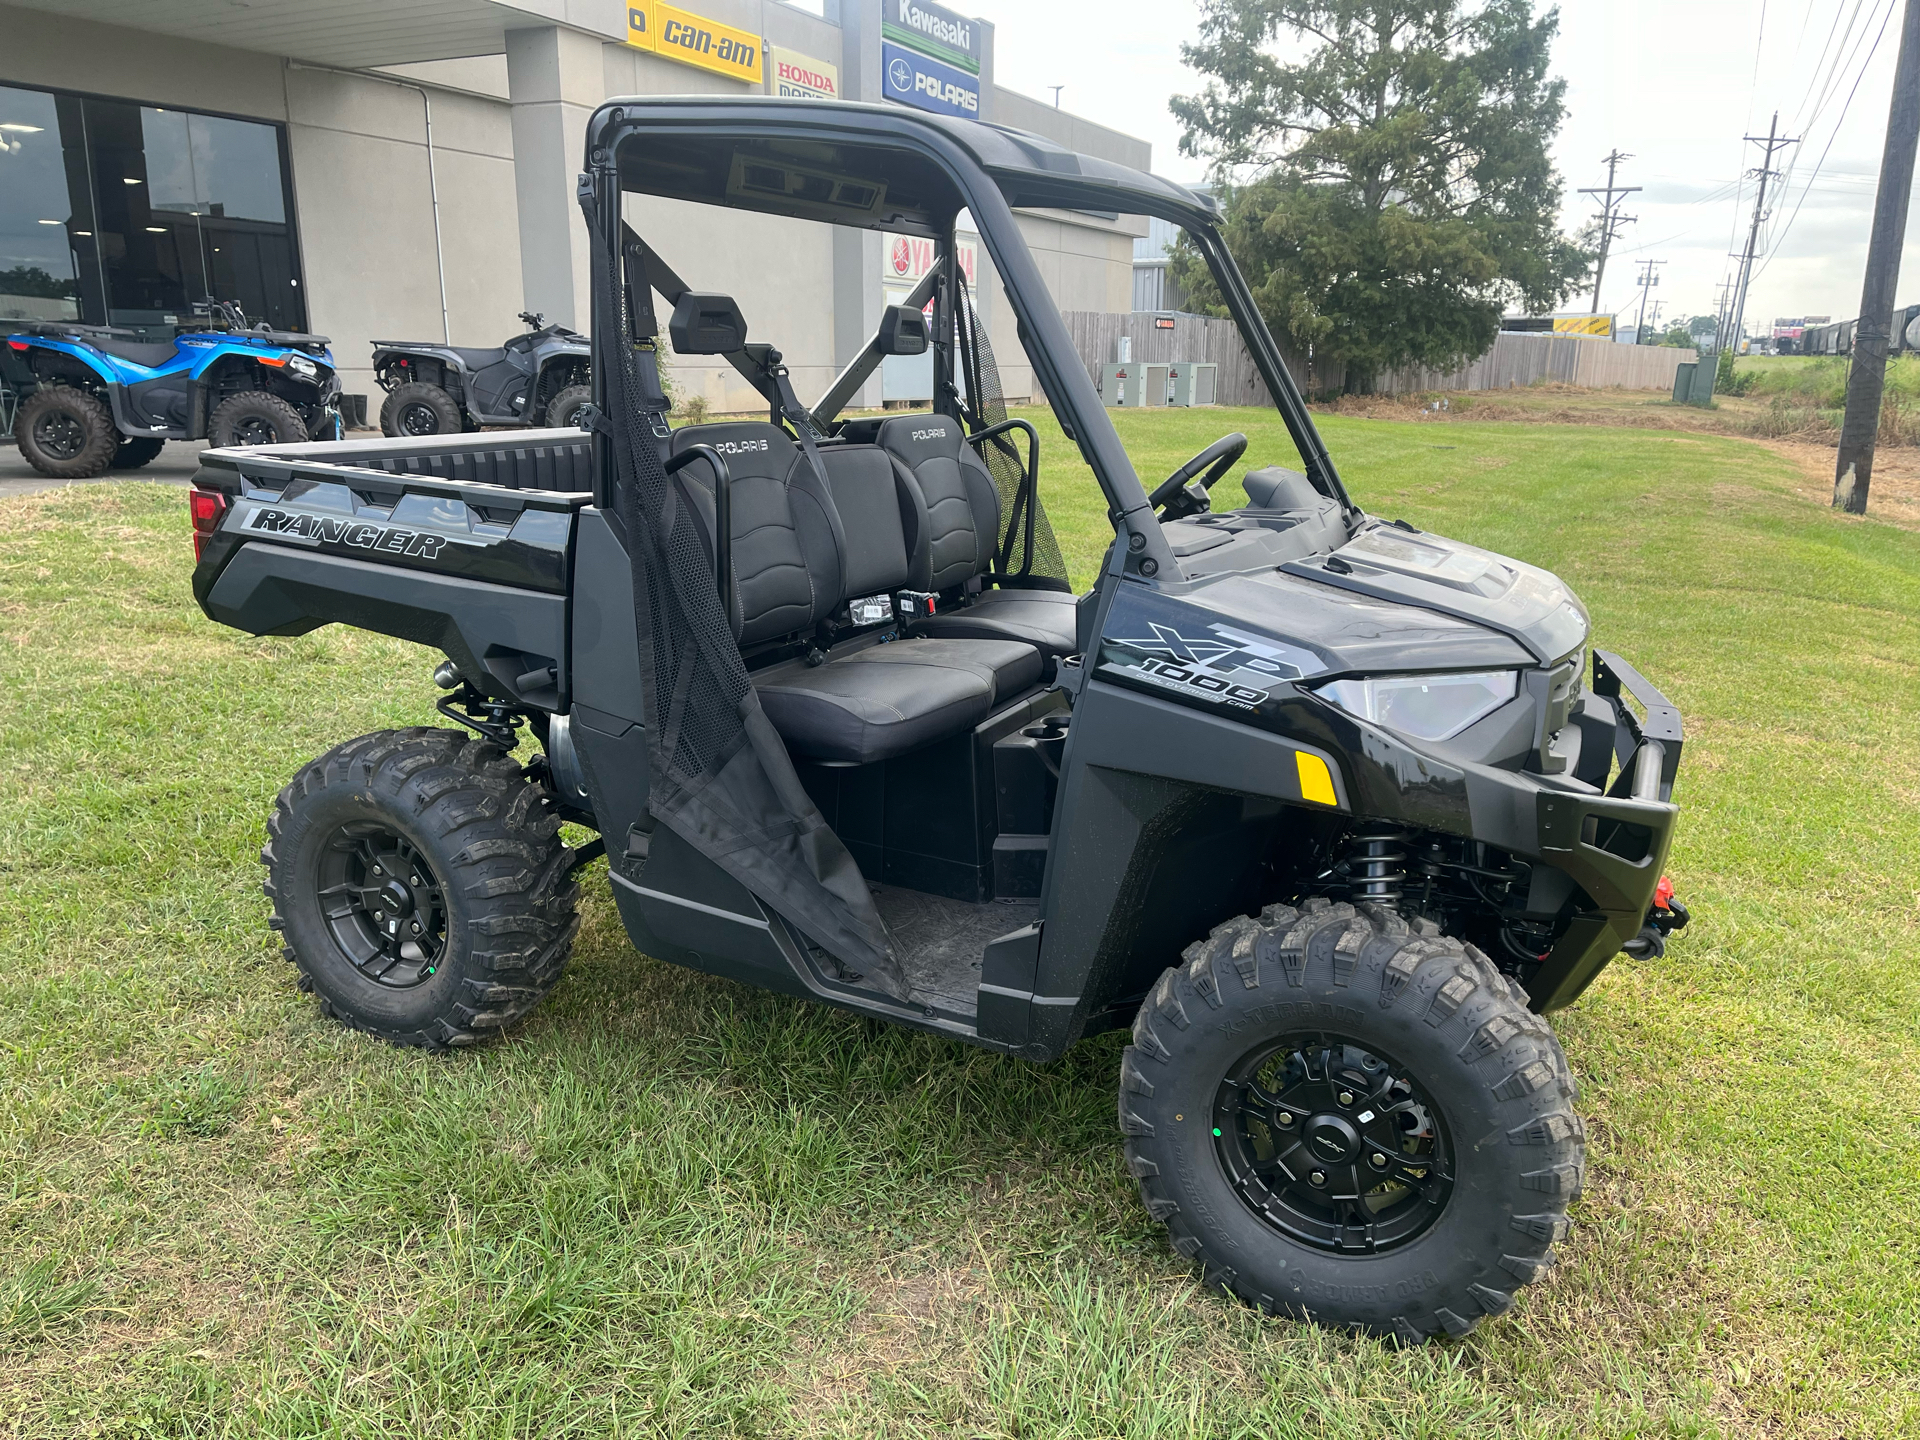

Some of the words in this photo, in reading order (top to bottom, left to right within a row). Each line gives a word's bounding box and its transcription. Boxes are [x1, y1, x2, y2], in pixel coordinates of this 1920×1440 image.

[664, 20, 755, 67] can-am
[900, 0, 970, 50] Kawasaki
[778, 61, 835, 93] HONDA
[915, 71, 978, 112] POLARIS
[716, 440, 769, 454] POLARIS
[912, 428, 946, 442] POLARIS
[250, 507, 447, 560] RANGER
[1111, 621, 1304, 682] XP
[1136, 672, 1164, 685] DUAL
[1226, 699, 1254, 710] CAM
[1140, 657, 1269, 705] 1000
